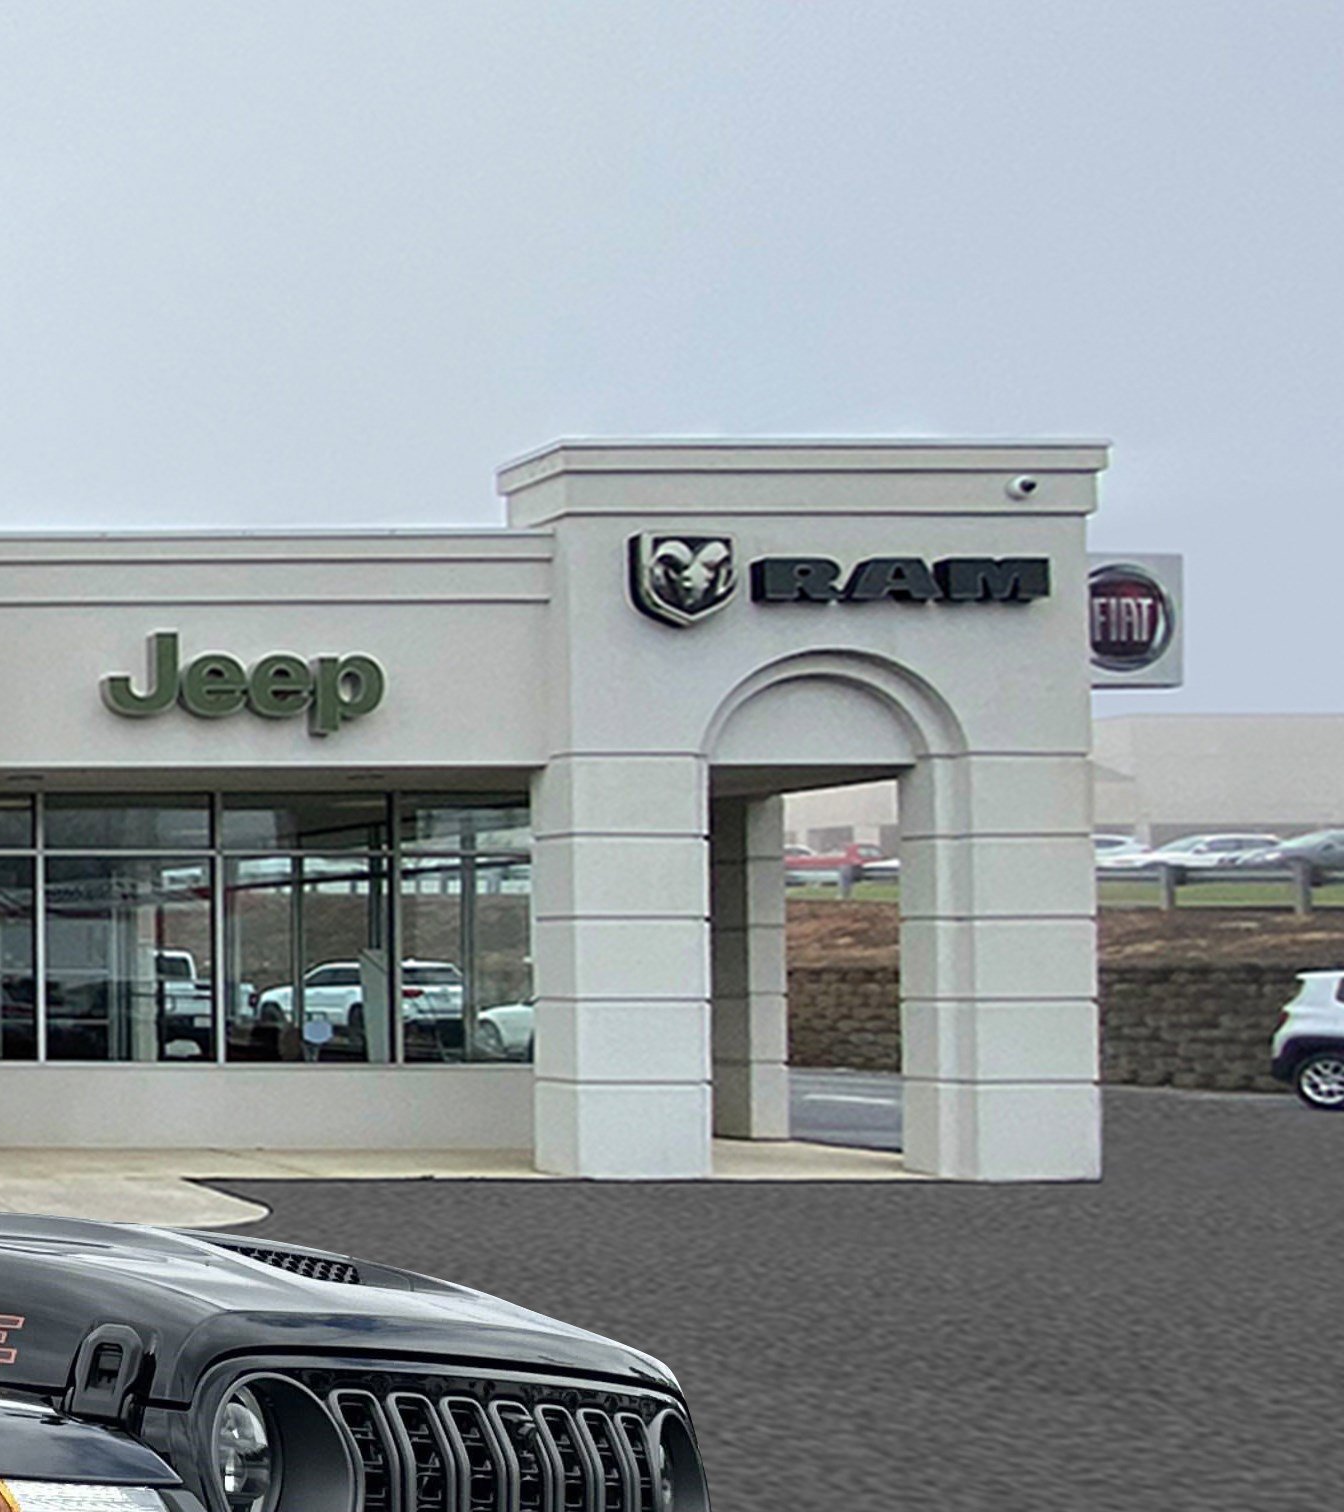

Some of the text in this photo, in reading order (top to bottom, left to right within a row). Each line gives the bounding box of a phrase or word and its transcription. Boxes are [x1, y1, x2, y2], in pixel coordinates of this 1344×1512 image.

[751, 556, 1051, 605] RAM
[1092, 597, 1153, 642] FIAT
[99, 630, 387, 736] Jeep
